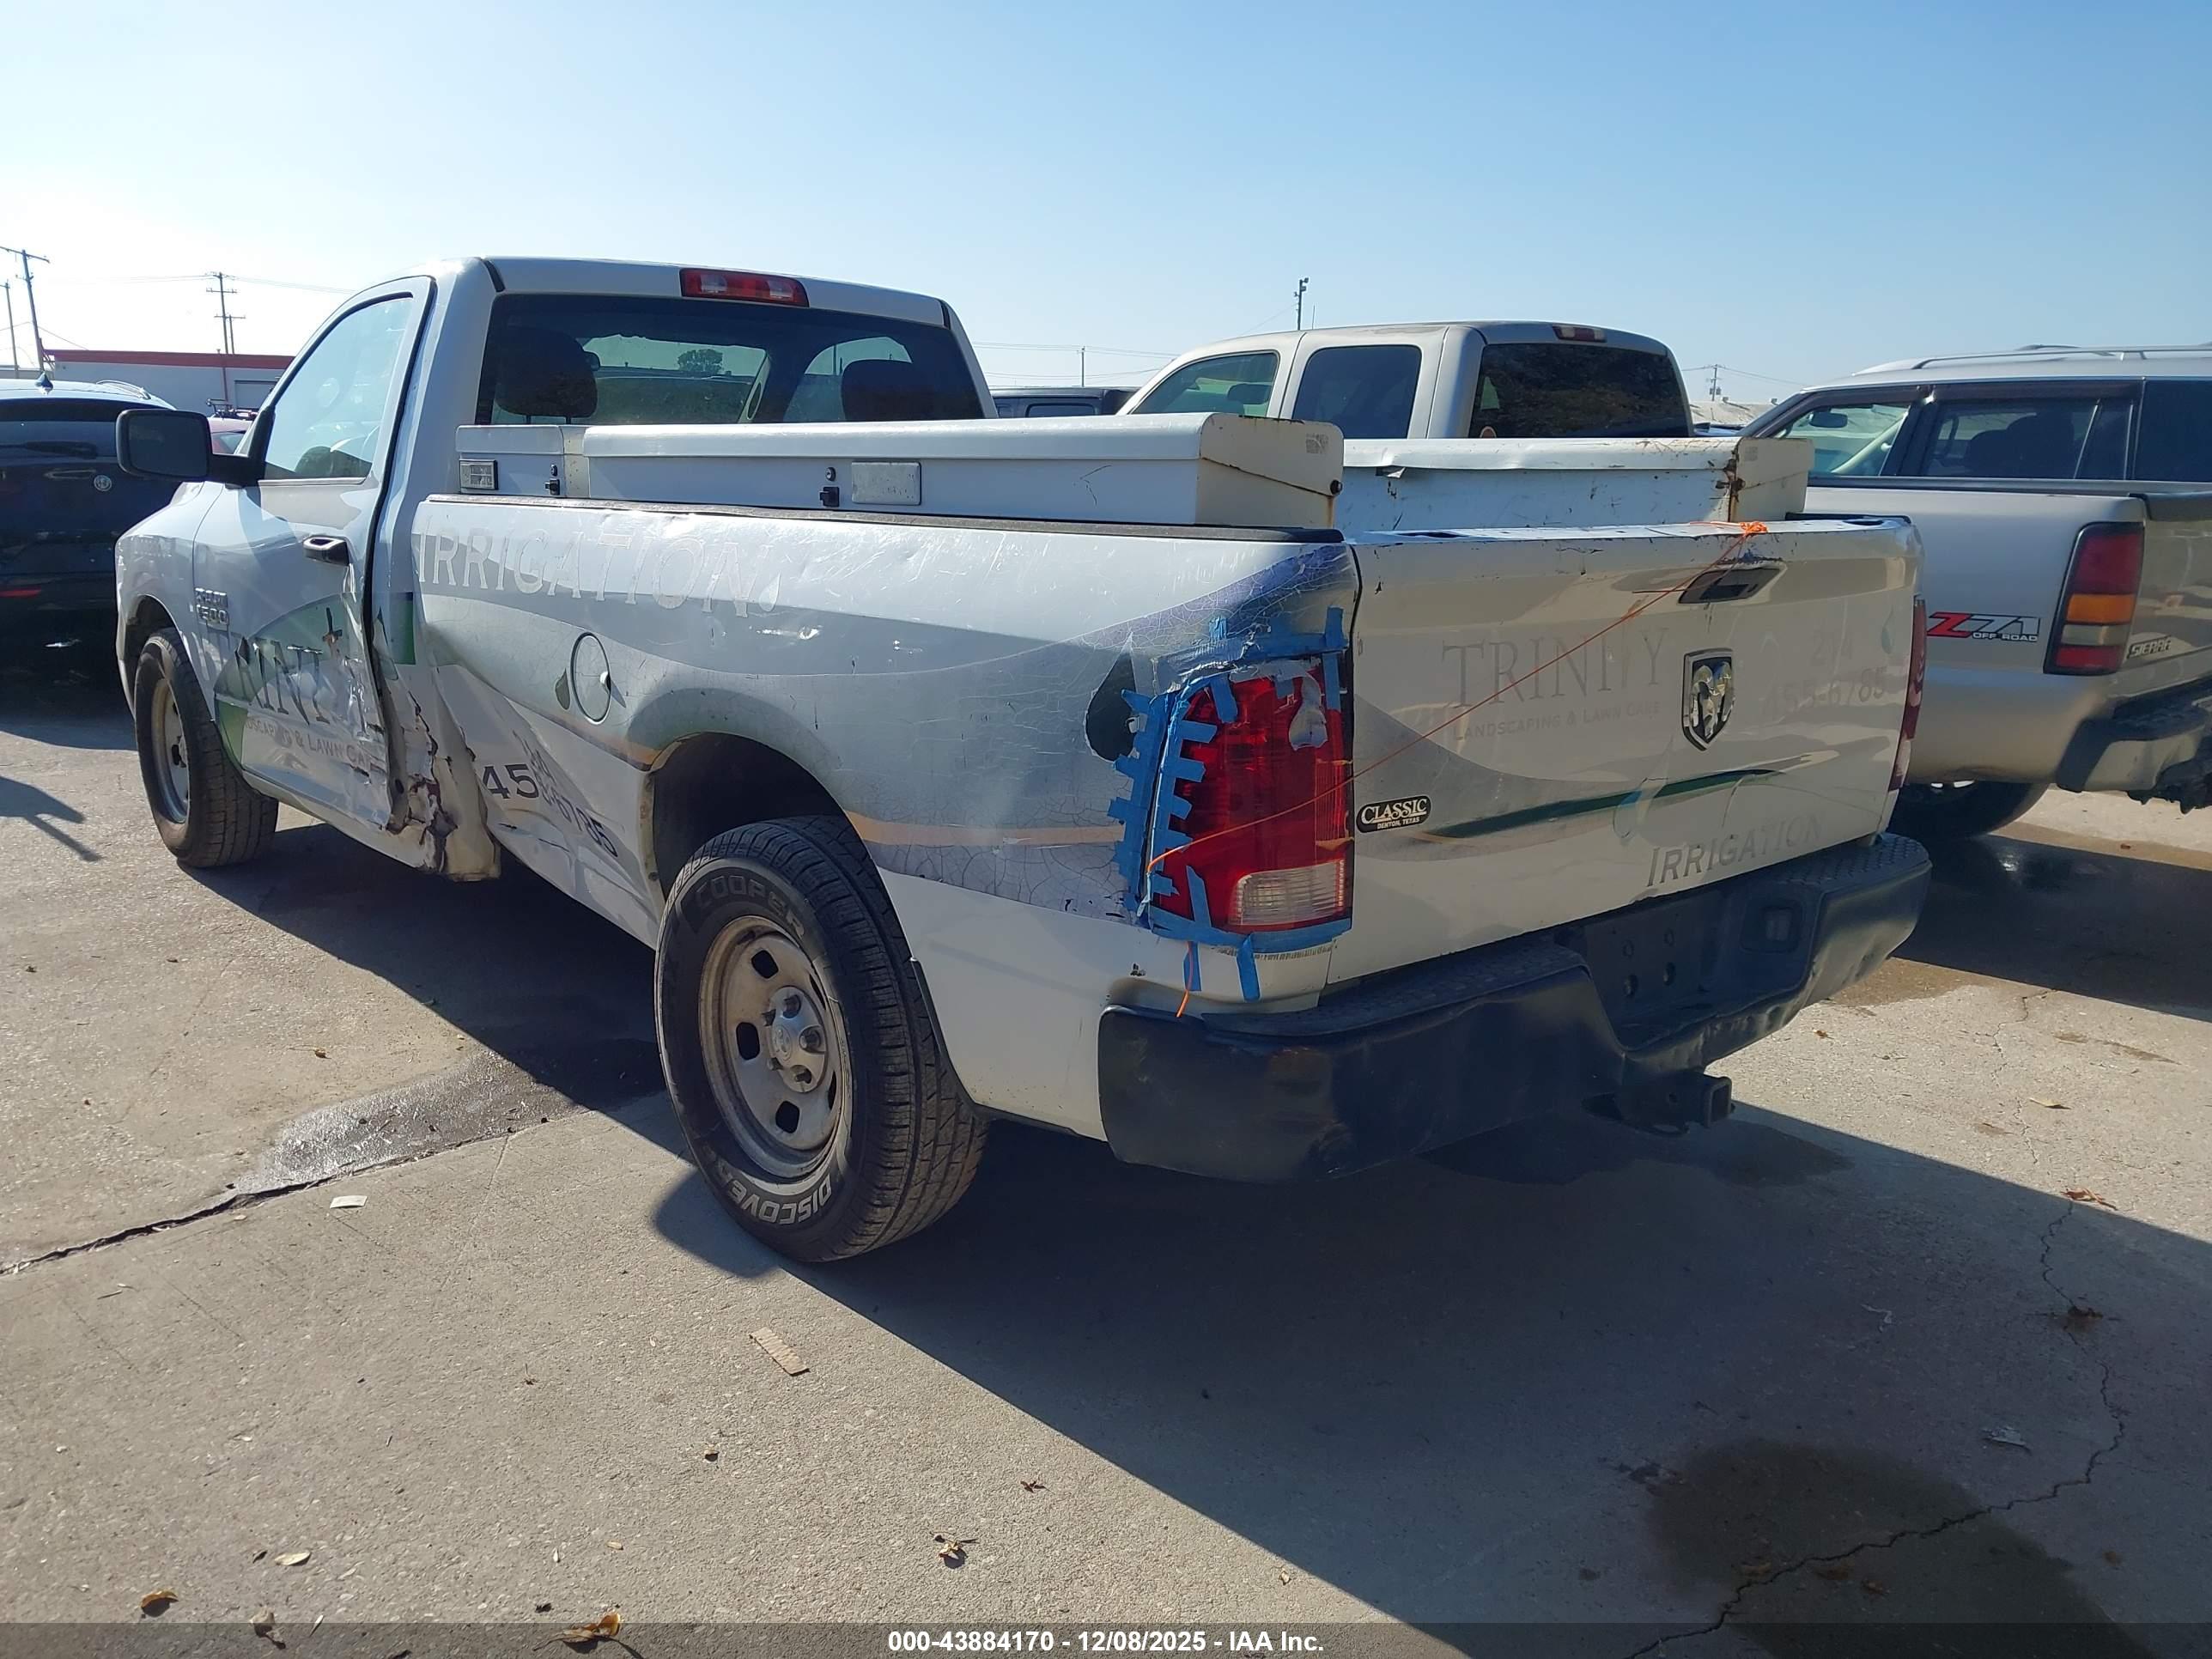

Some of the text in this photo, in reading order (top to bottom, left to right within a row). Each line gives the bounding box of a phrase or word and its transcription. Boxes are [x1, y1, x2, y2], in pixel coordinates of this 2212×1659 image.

[417, 517, 774, 617] IRRIGATION
[1927, 612, 2041, 639] Z71
[2001, 633, 2039, 642] ROAD
[2130, 636, 2171, 657] SIERRA
[1453, 714, 1561, 741] LANDSCAPING
[1583, 704, 1622, 725] LAWN
[307, 732, 344, 757] LAWN
[1361, 799, 1427, 825] CLASSIC
[1376, 817, 1420, 830] DENTON, TEXAS
[1647, 813, 1821, 887] IRRIGATION
[694, 874, 805, 939] COOPER
